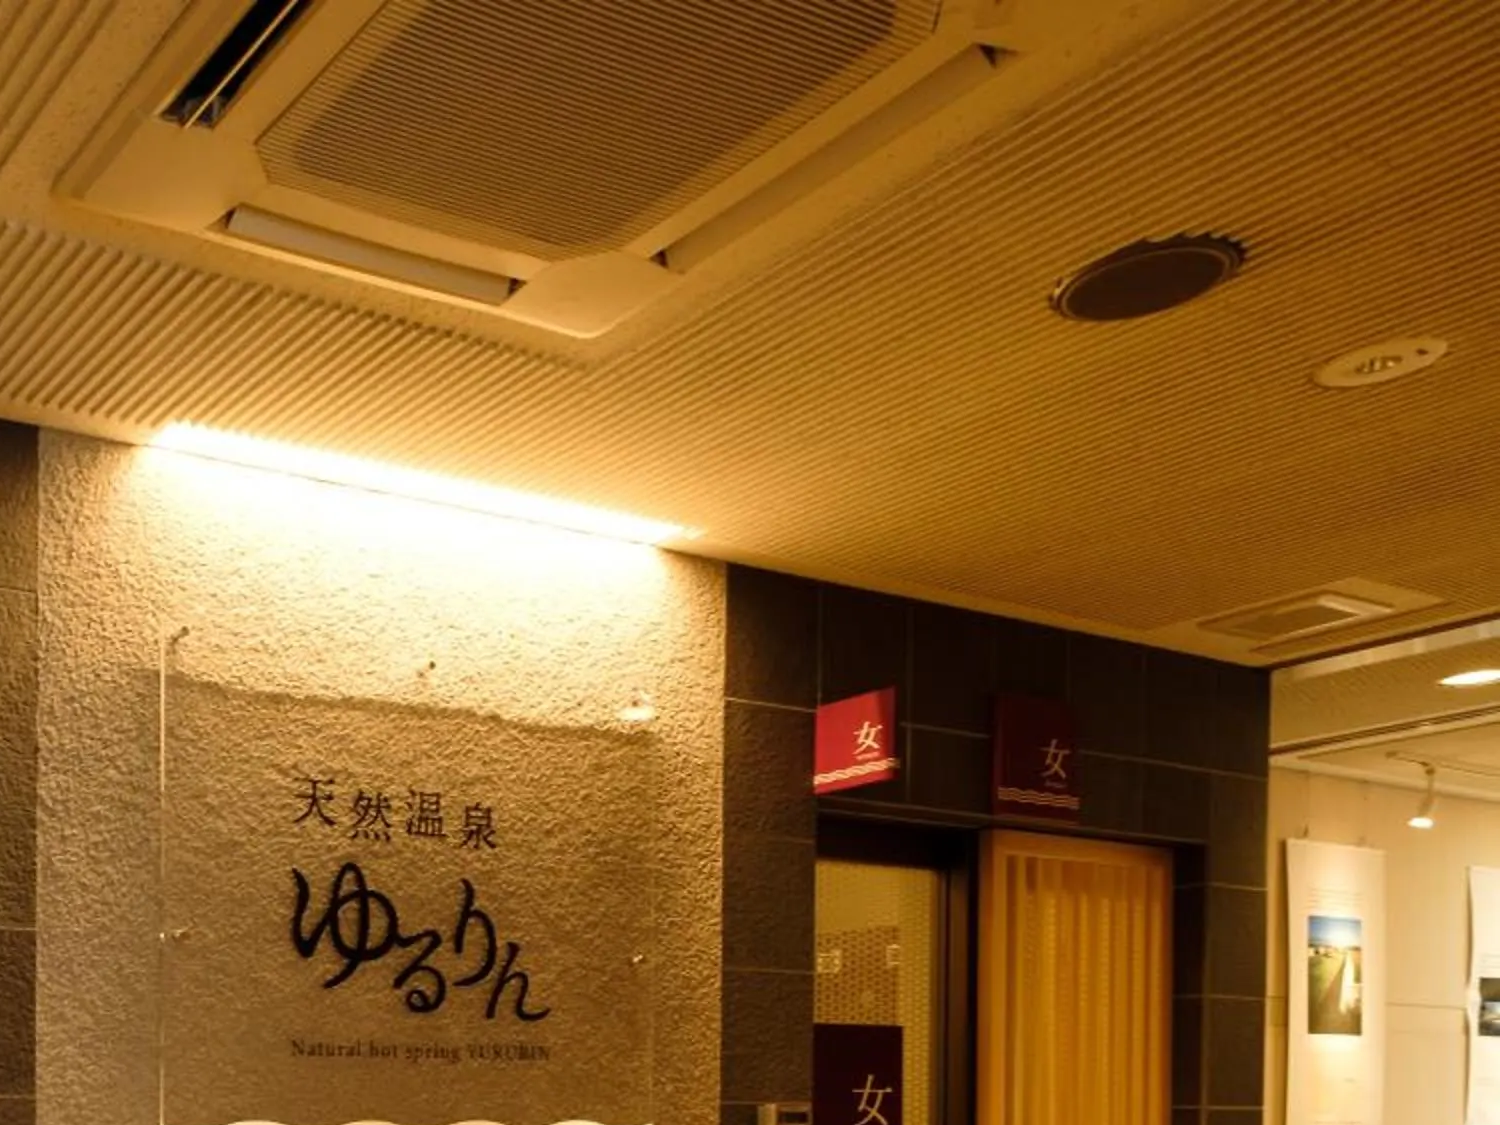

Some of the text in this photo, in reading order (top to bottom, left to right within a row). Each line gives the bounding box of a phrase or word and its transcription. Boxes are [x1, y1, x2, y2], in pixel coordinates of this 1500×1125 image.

[852, 720, 884, 755] 女
[1040, 738, 1071, 779] 女
[292, 777, 497, 850] 天然温泉
[290, 861, 551, 1022] ゆるりん
[291, 1039, 362, 1059] Natural
[369, 1039, 399, 1060] hot
[405, 1042, 462, 1065] spring
